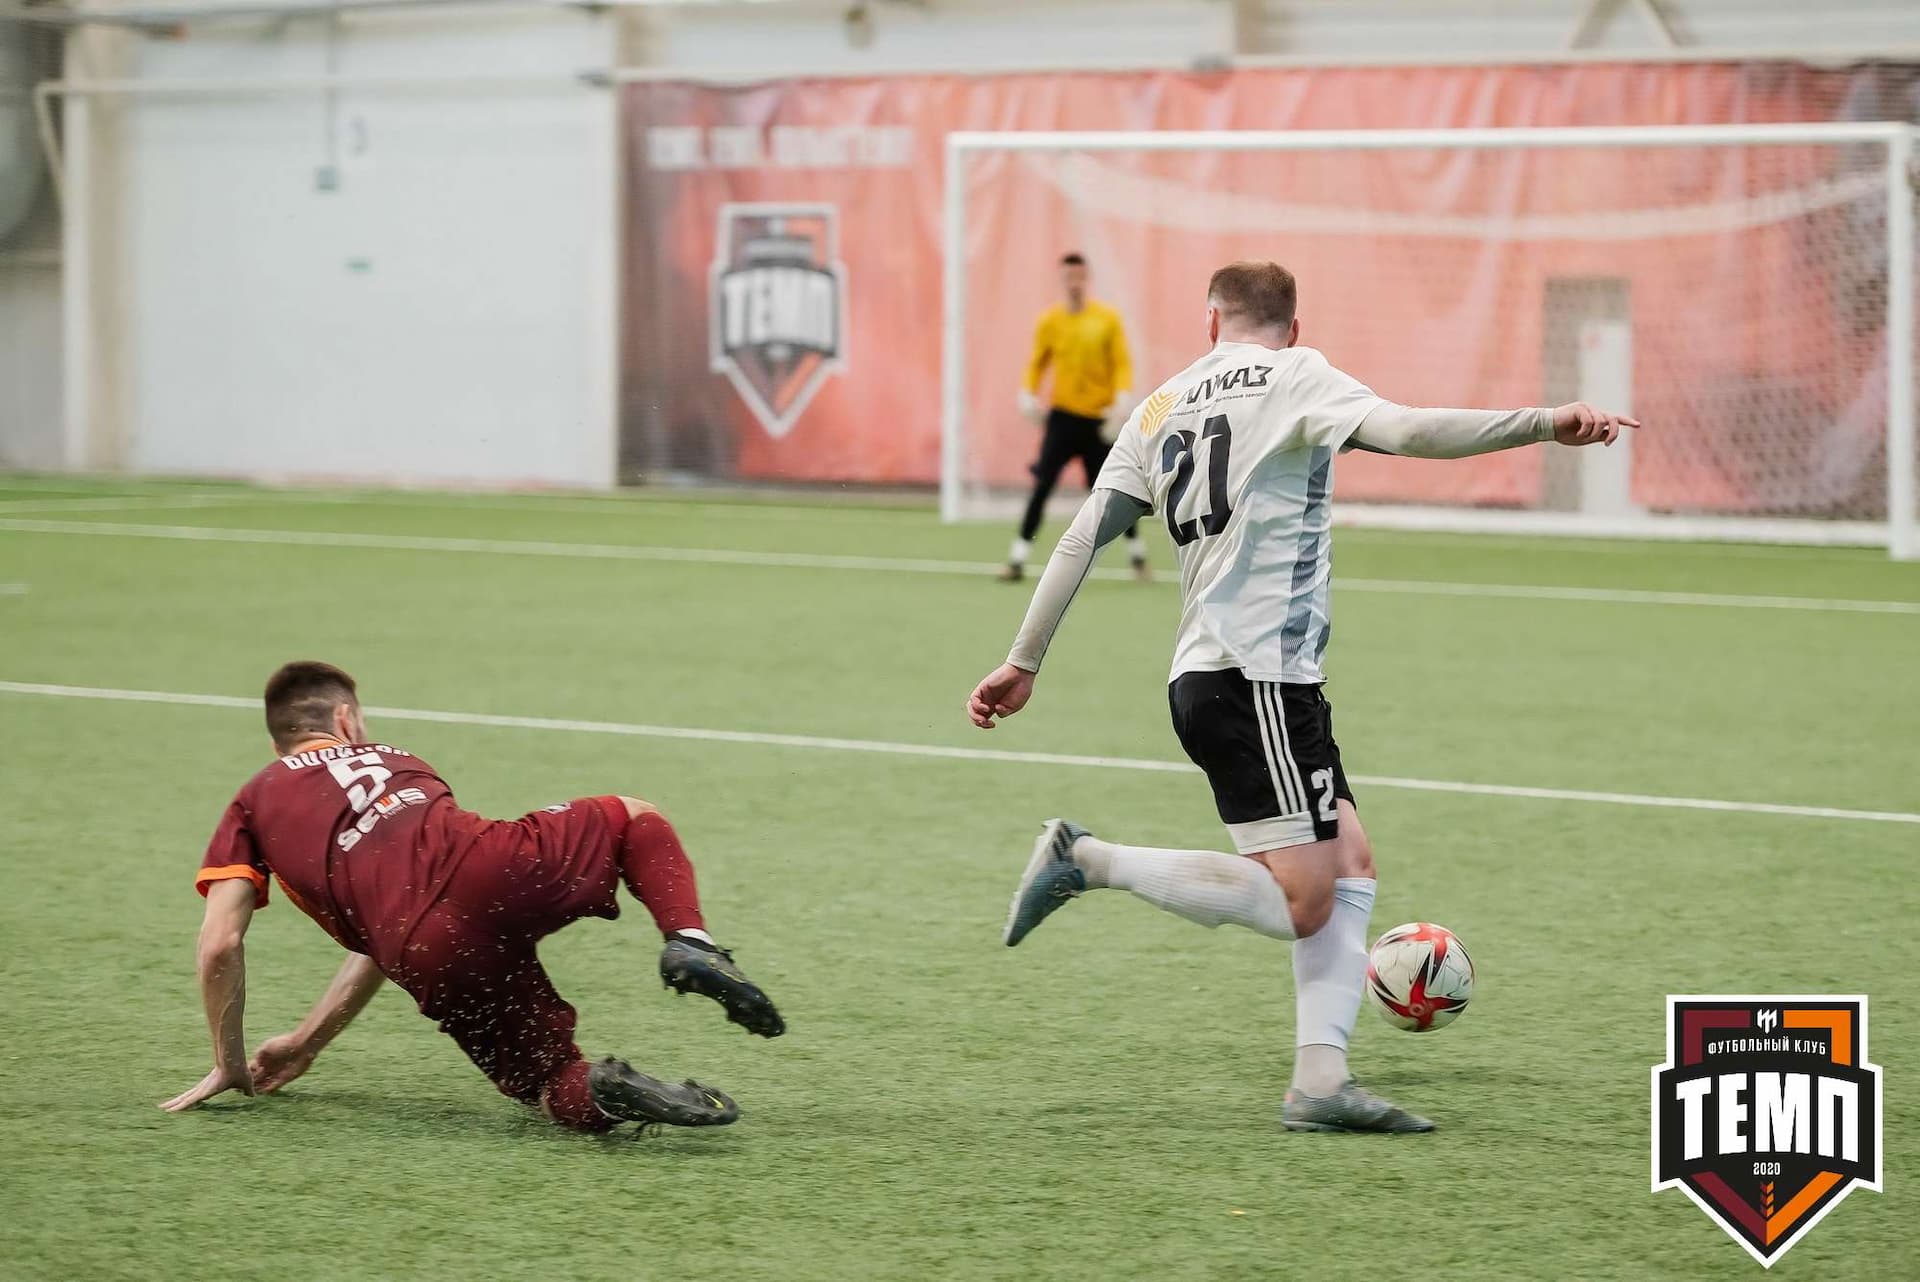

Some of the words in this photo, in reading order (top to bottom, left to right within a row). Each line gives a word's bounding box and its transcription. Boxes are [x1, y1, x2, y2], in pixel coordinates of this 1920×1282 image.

[1161, 413, 1234, 547] 21
[326, 751, 393, 814] 5
[1310, 766, 1338, 822] 2
